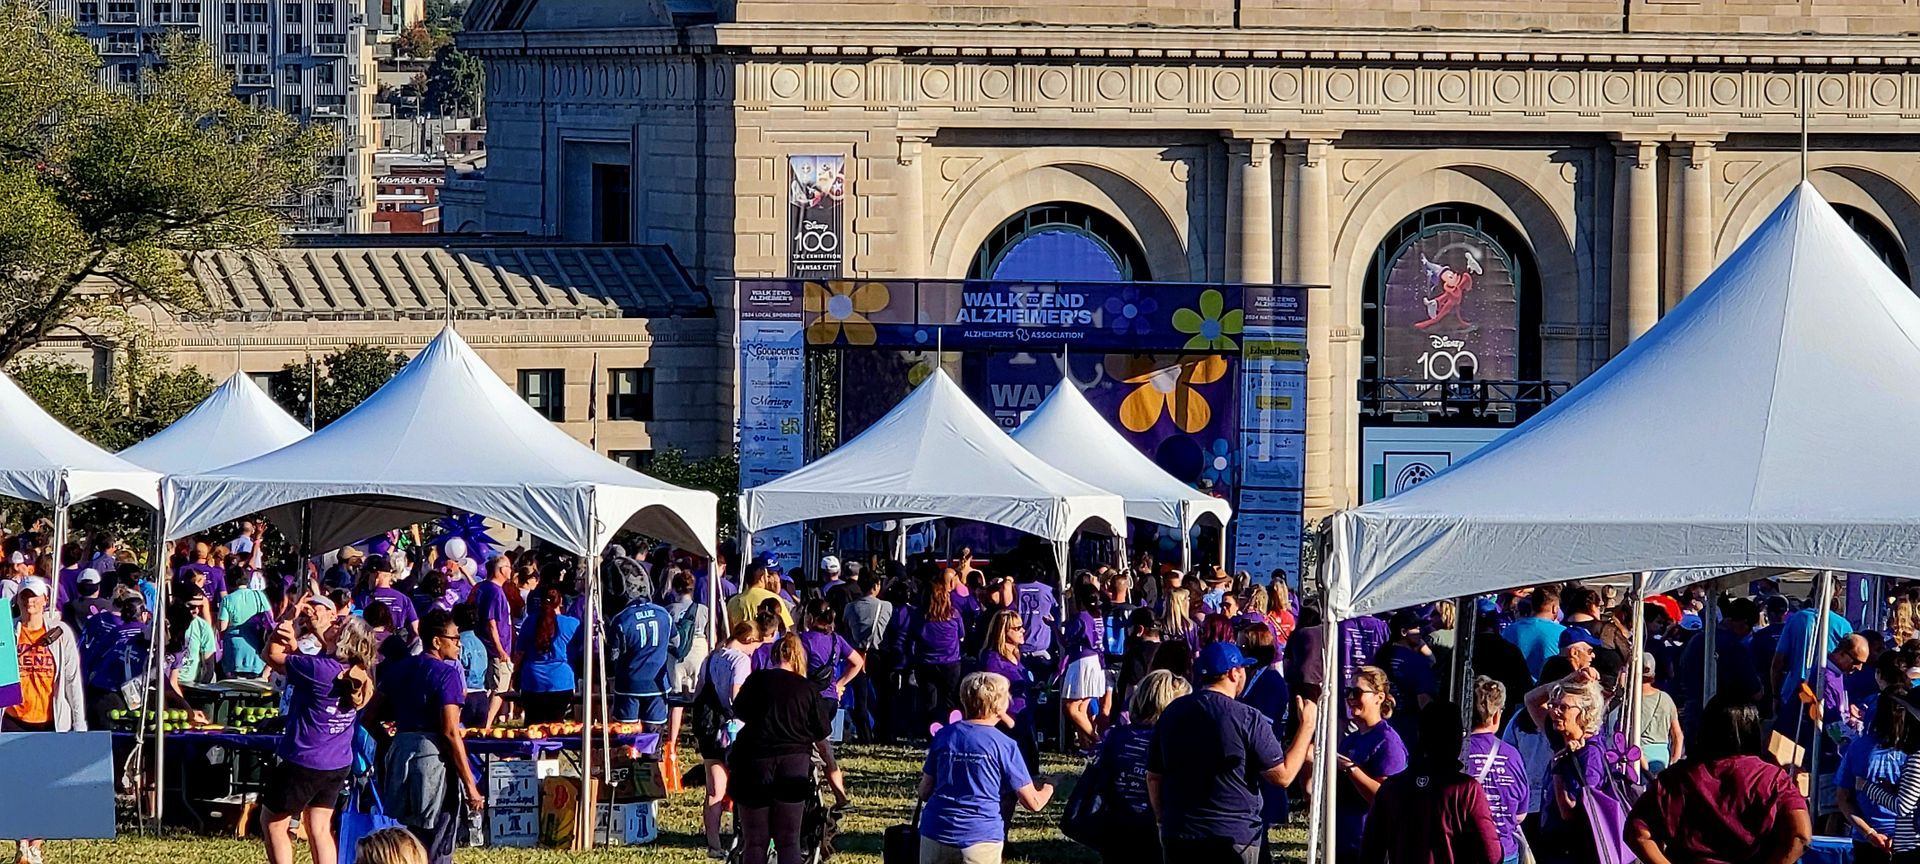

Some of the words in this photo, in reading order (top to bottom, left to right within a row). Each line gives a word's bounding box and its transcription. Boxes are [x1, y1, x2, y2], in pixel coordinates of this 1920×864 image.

[803, 220, 828, 231] Disney
[794, 231, 838, 252] 100
[963, 293, 1023, 308] WALK
[1028, 296, 1038, 304] TO
[1041, 293, 1085, 308] END
[955, 308, 1092, 324] ALZHEIMER'S
[963, 330, 1015, 338] ALZHEIMER'S
[1030, 331, 1084, 340] ASSOCIATION
[1429, 335, 1464, 351] Disney
[1416, 350, 1478, 380] 100
[997, 417, 1014, 426] TO
[635, 610, 655, 619] BLUE
[636, 620, 659, 649] 11
